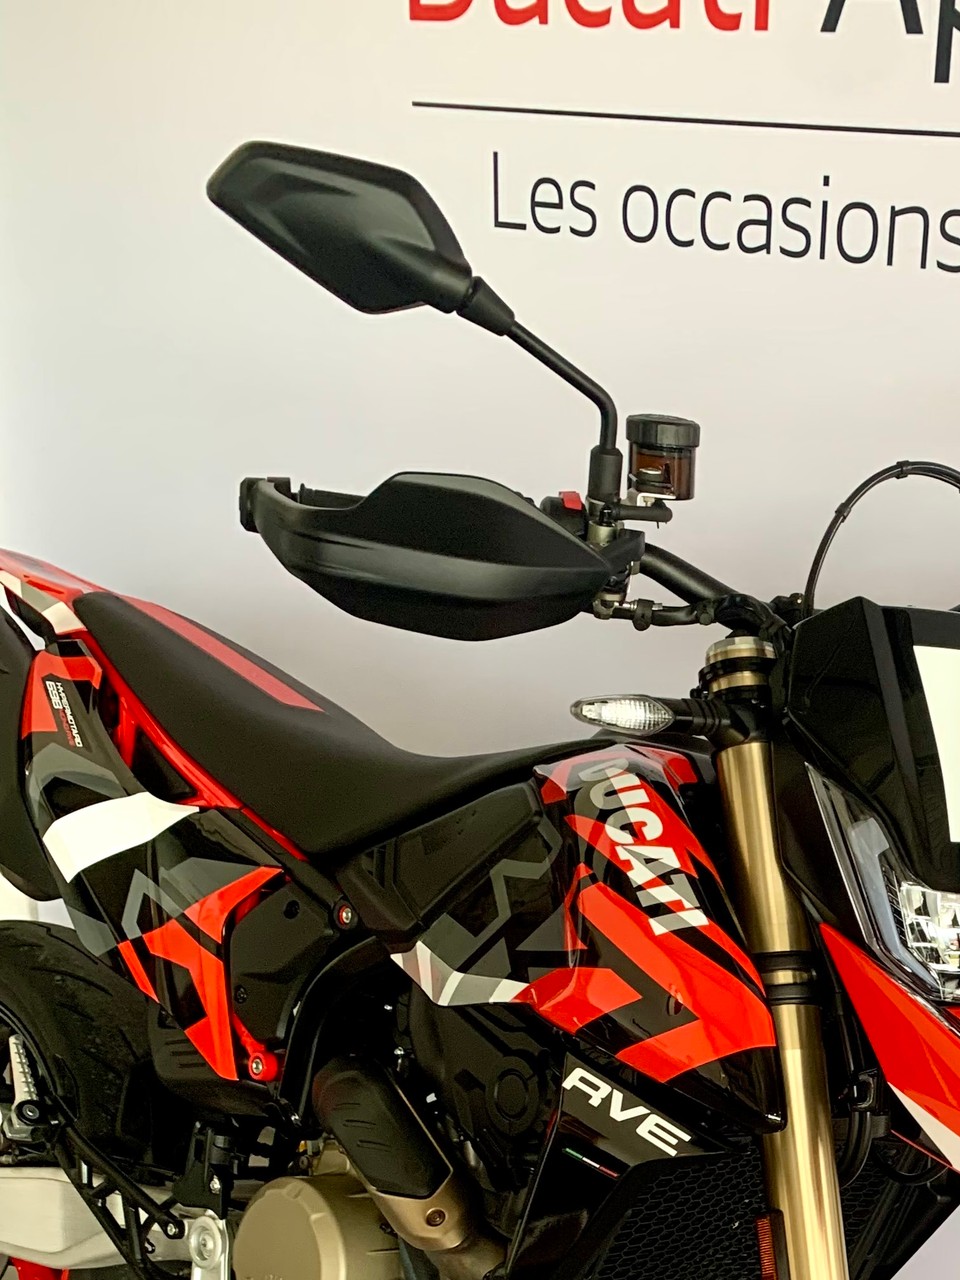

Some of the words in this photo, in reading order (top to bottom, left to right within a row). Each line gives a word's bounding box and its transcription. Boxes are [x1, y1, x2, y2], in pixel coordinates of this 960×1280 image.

[493, 151, 598, 238] Les
[578, 758, 709, 936] DUCATI
[561, 1067, 692, 1157] RVE
